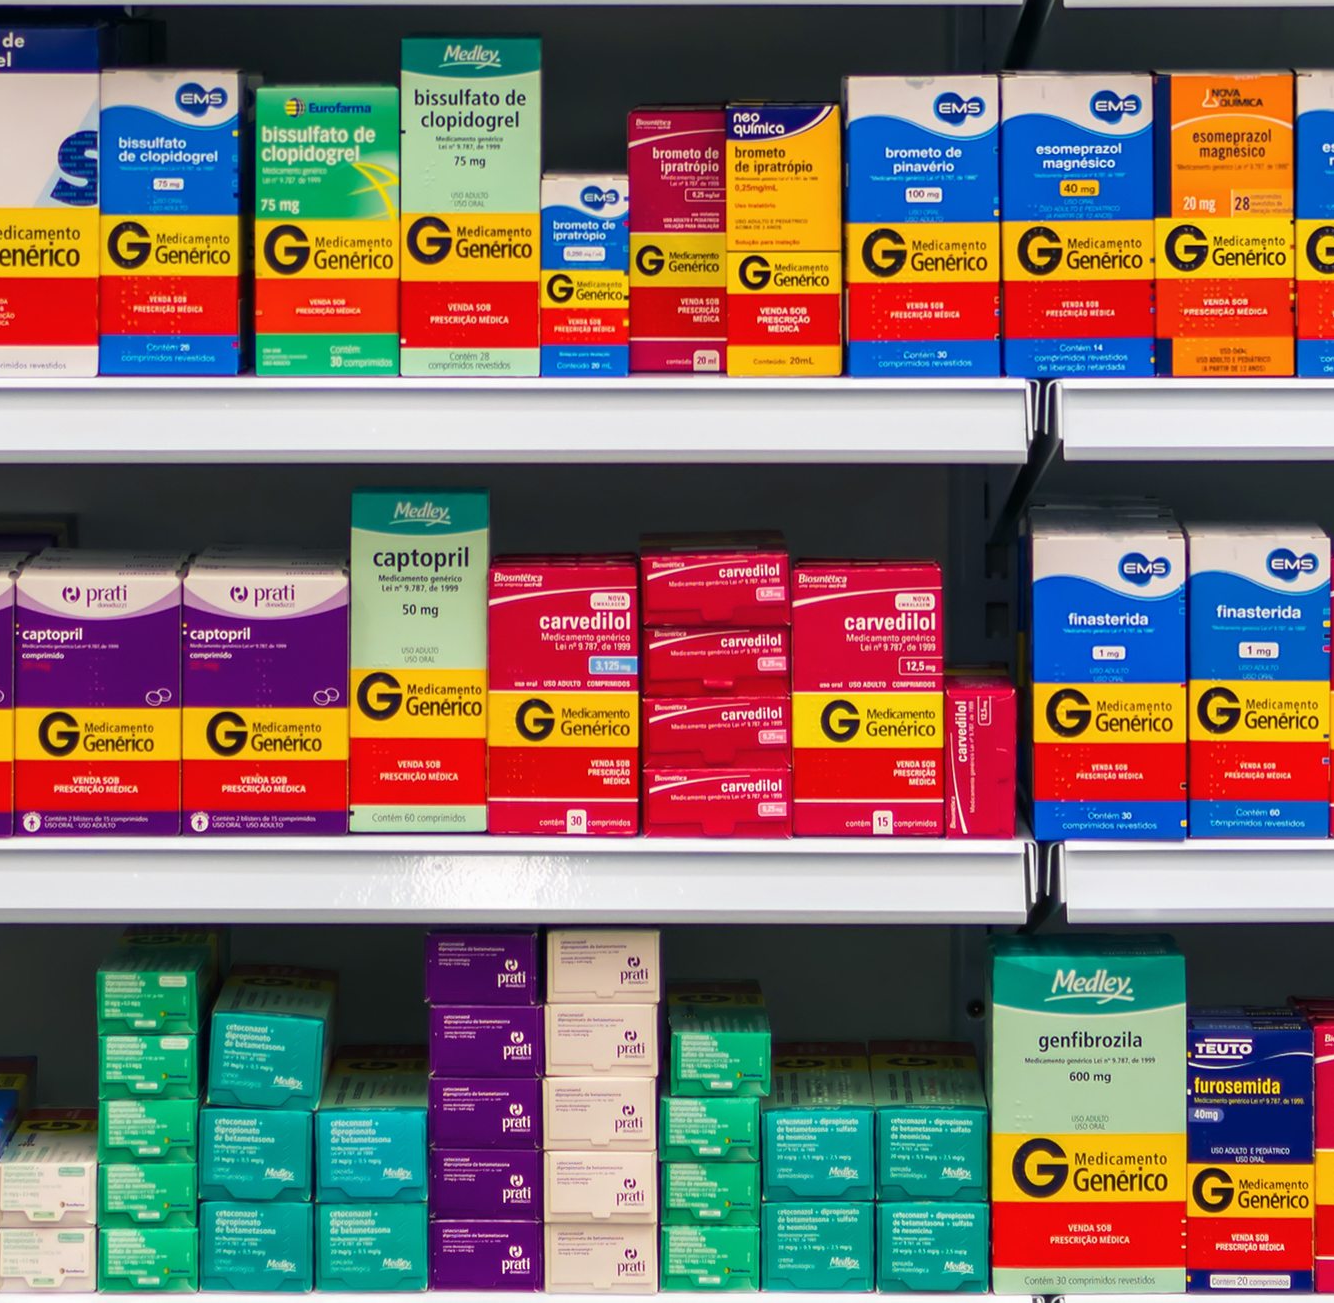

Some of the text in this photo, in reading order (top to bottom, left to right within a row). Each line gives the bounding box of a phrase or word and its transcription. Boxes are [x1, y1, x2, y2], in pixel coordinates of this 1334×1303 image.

[652, 146, 719, 160] brometo de
[661, 160, 719, 176] ipratrópio
[893, 160, 955, 175] pinavério
[1183, 196, 1216, 214] 20 mg
[1234, 196, 1250, 211] 28
[539, 611, 631, 630] carvedilol
[595, 660, 620, 672] 3,125
[954, 701, 968, 763] carvedilol
[877, 816, 889, 827] 15
[1038, 1030, 1142, 1053] genfibrozila
[1195, 1041, 1254, 1057] TEUTO
[1194, 1076, 1281, 1095] furosemida
